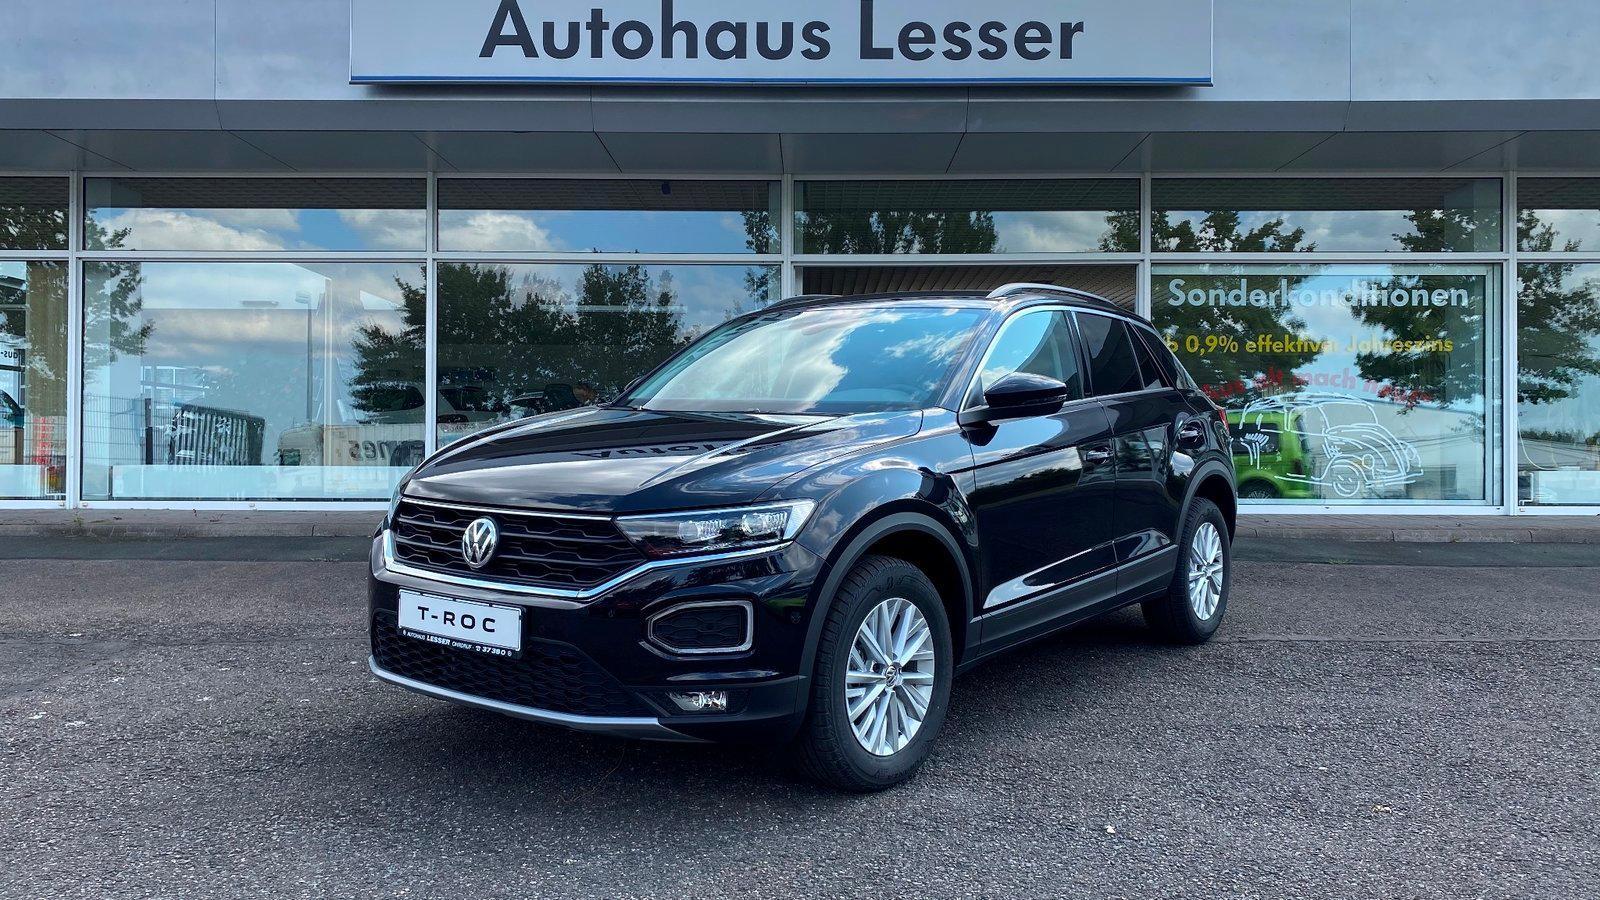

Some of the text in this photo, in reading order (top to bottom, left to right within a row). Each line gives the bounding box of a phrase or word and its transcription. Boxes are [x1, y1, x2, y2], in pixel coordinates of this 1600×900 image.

[479, 0, 1084, 61] Autohaus Lesser
[1168, 278, 1468, 307] Sonderkonditionen
[1186, 334, 1238, 356] 0,9%
[1346, 332, 1454, 352] Jahreszins
[1294, 368, 1357, 389] mach
[417, 605, 496, 633] T-ROC
[426, 634, 451, 646] LESSER
